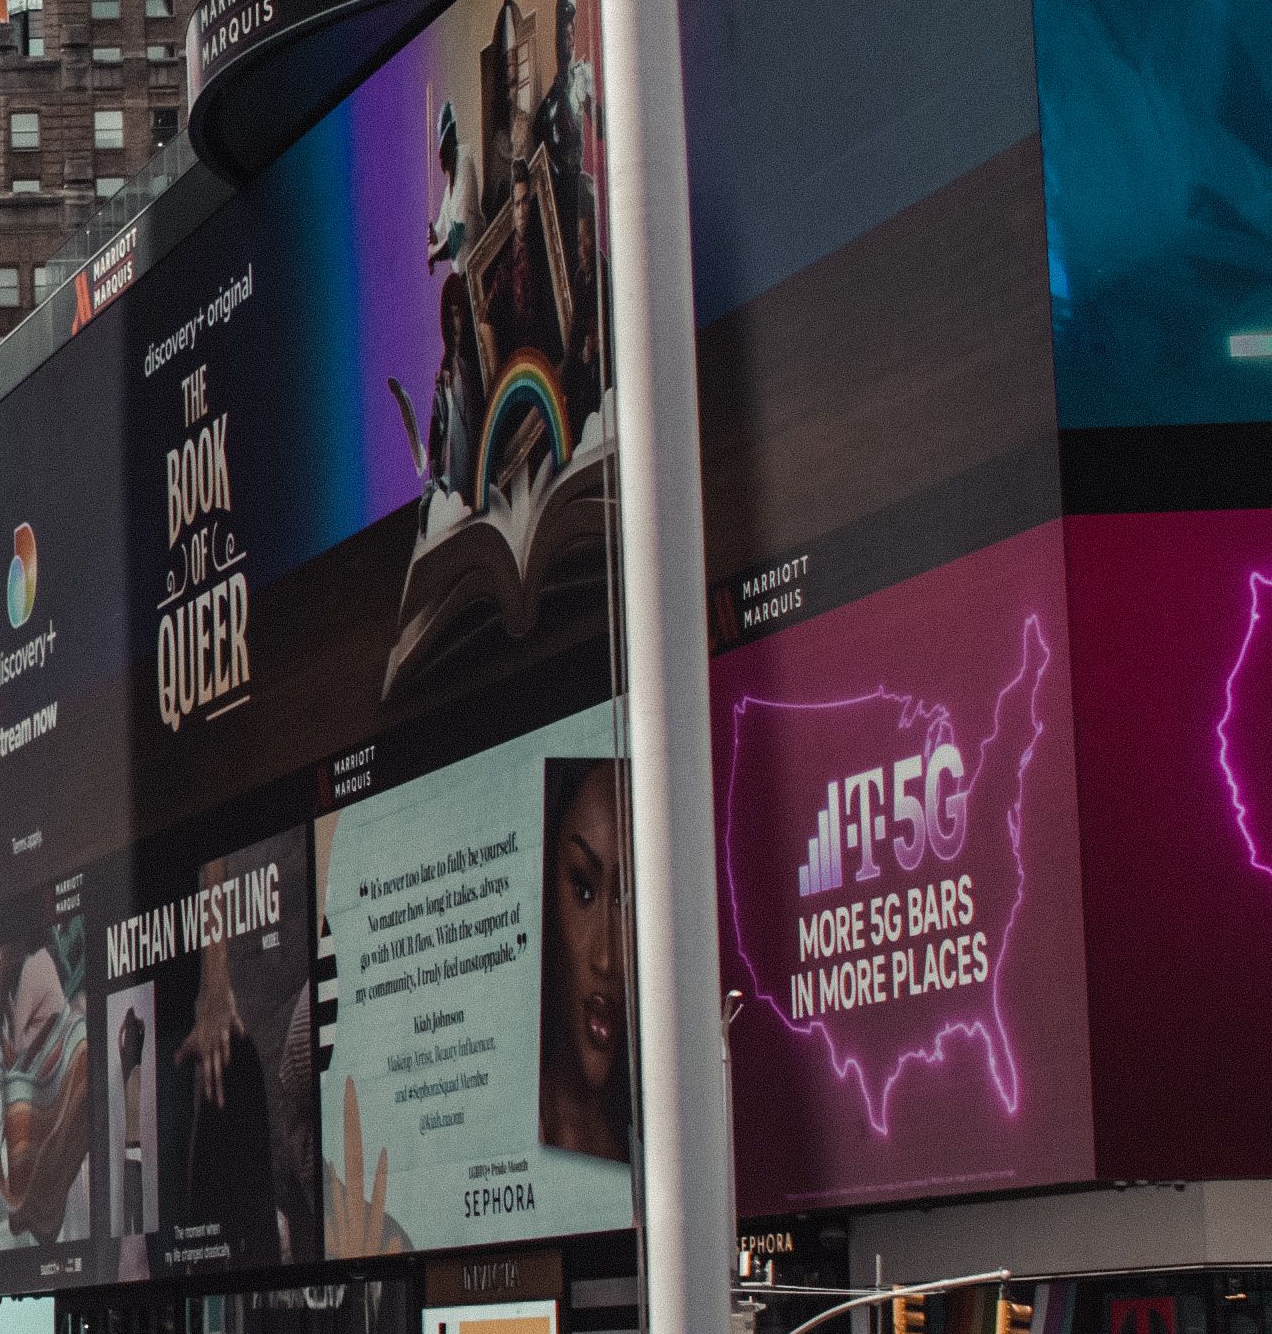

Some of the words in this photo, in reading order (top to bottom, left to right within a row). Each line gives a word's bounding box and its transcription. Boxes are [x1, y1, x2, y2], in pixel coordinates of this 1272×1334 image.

[93, 227, 136, 283] MARRIOTT
[94, 261, 134, 310] MARQUIS
[145, 307, 205, 378] discovery+
[208, 263, 252, 328] original
[182, 364, 209, 427] THE
[166, 413, 231, 550] BOOK
[191, 528, 209, 585] OF
[742, 555, 809, 600] MARRIOTT
[743, 588, 803, 629] MARQUIS
[157, 572, 250, 733] QUEER
[33, 702, 57, 738] now
[335, 745, 375, 777] MARRIOTT
[335, 771, 371, 798] MARQUIS
[893, 742, 968, 871] 5G
[384, 877, 404, 895] never
[406, 871, 419, 887] too
[421, 863, 436, 882] late
[437, 860, 446, 878] to
[447, 850, 465, 873] fully
[468, 847, 478, 865] be
[107, 902, 175, 980] NATHAN
[181, 862, 280, 954] WESTLING
[379, 907, 406, 931] matter
[407, 902, 424, 922] how
[426, 896, 445, 917] long
[446, 889, 452, 909] it
[479, 876, 510, 898] always
[798, 901, 866, 963] MORE
[869, 894, 903, 943] 5G
[908, 874, 975, 929] BARS
[360, 953, 370, 973] go
[371, 943, 389, 964] with
[391, 936, 413, 960] YOUR
[436, 923, 457, 945] With
[459, 919, 473, 940] the
[475, 910, 509, 938] support
[510, 902, 520, 925] of
[355, 987, 367, 1005] my
[422, 963, 442, 985] truly
[443, 957, 458, 980] feel
[790, 972, 814, 1020] IN
[819, 954, 887, 1015] MORE
[892, 932, 989, 1000] PLACES
[464, 1182, 536, 1219] SEPHORA
[737, 1232, 793, 1254] EPHORA
